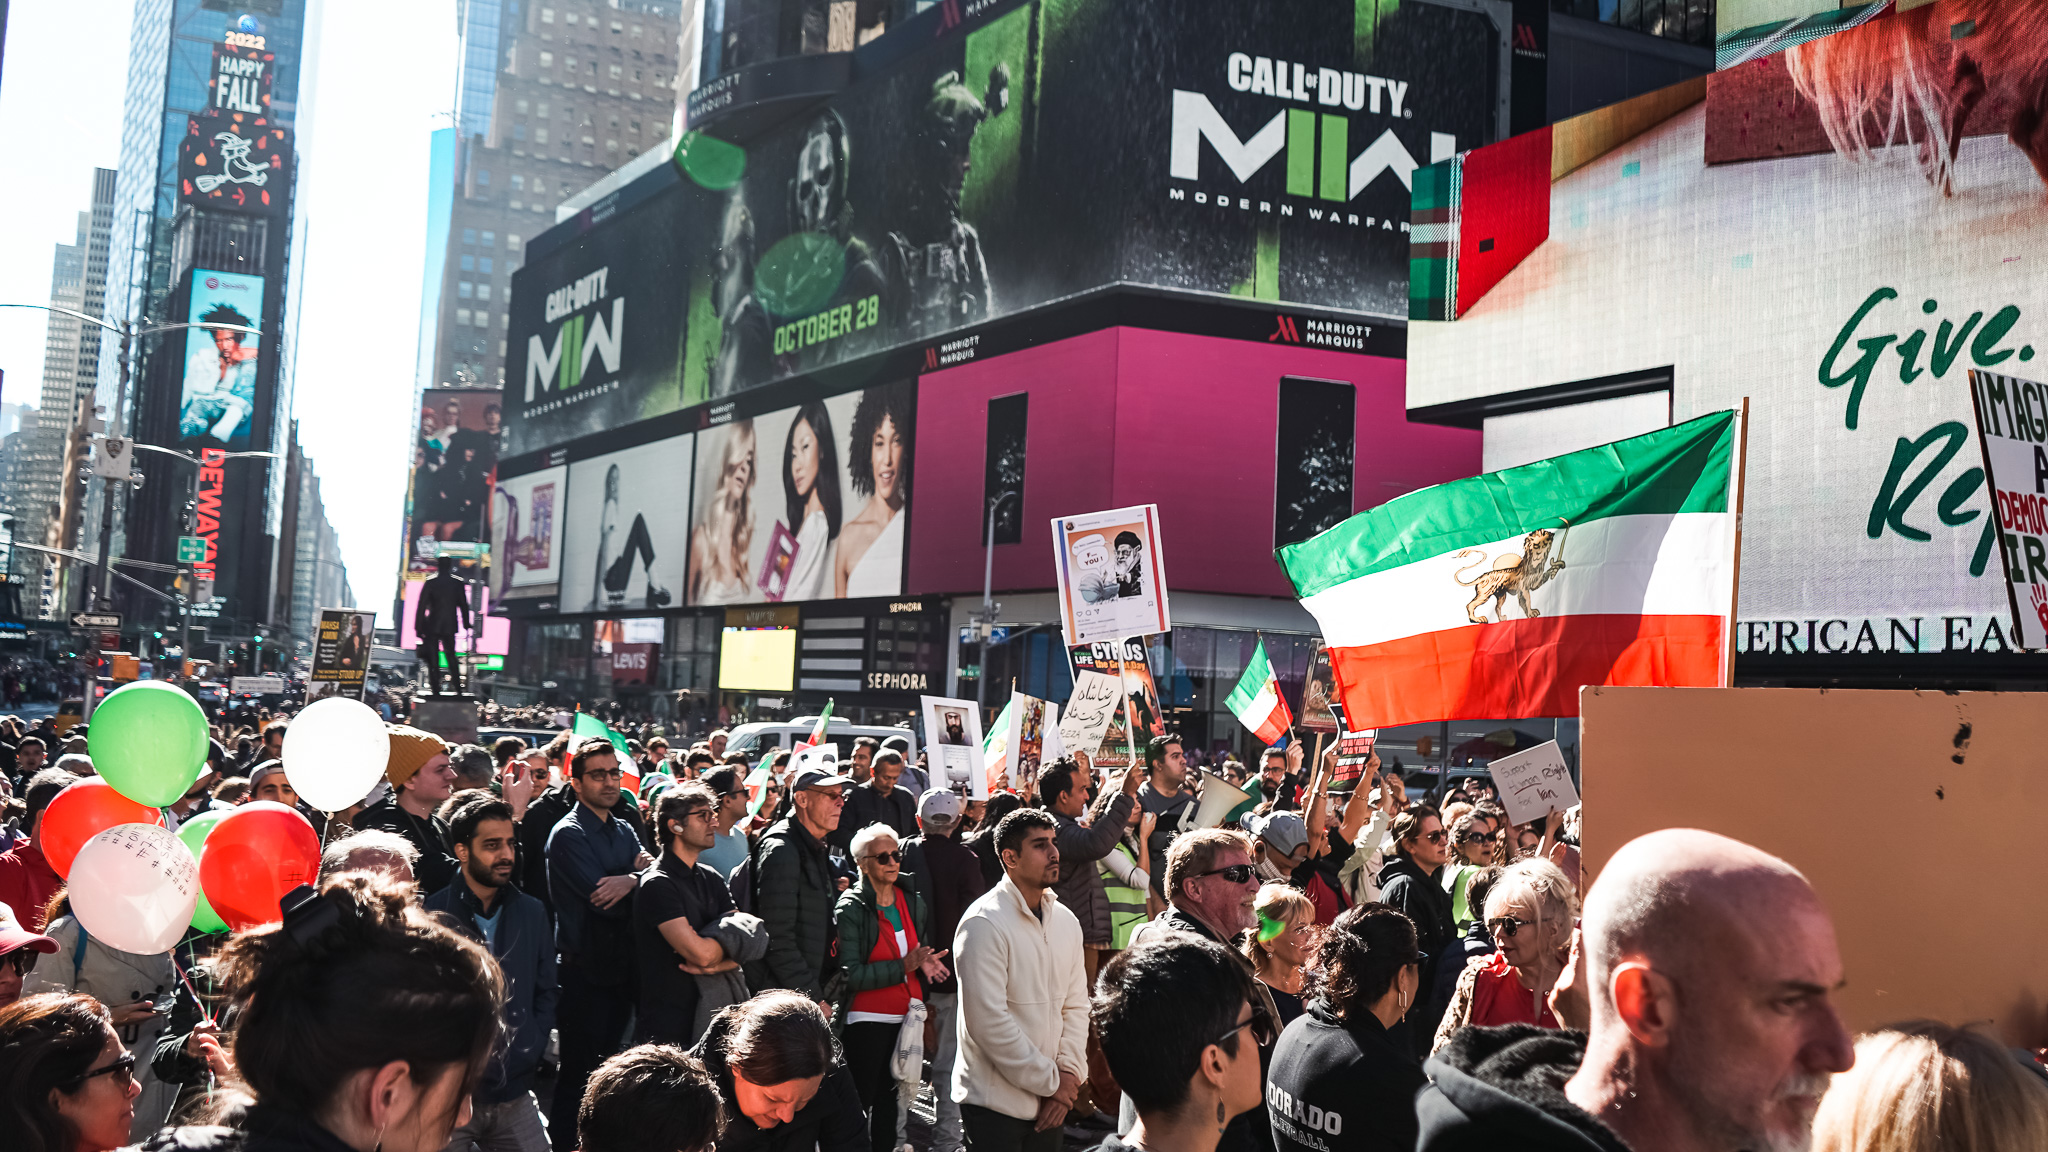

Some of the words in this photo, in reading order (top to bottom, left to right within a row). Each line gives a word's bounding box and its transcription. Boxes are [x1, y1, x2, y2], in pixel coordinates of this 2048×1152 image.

[225, 30, 266, 50] 2022
[219, 55, 265, 79] HAPPY
[216, 75, 262, 114] FALL
[691, 73, 741, 104] MARRIOTT
[1227, 52, 1310, 102] CALL
[1305, 72, 1319, 89] OF
[1318, 66, 1408, 118] DUTY
[690, 91, 733, 119] MARQUIS
[1169, 188, 1294, 217] MODERN
[1309, 207, 1412, 234] WARFAR
[774, 303, 853, 356] OCTOBER
[855, 294, 880, 331] 28
[1306, 319, 1372, 338] MARRIOTT
[940, 334, 980, 354] MARRIOTT
[1306, 332, 1364, 350] MARQUIS
[940, 348, 975, 365] MARQUIS
[1818, 286, 2036, 431] Give.
[1973, 369, 2048, 446] IMAGI
[1084, 557, 1099, 566] YOU
[889, 602, 922, 613] SEPHORA
[1736, 616, 1925, 653] ERICAN
[1941, 615, 2021, 653] EA
[1074, 655, 1094, 665] LIFE
[1094, 659, 1109, 669] the
[1131, 662, 1146, 673] Day
[867, 672, 928, 690] SEPHORA
[1268, 1080, 1342, 1136] DORADO
